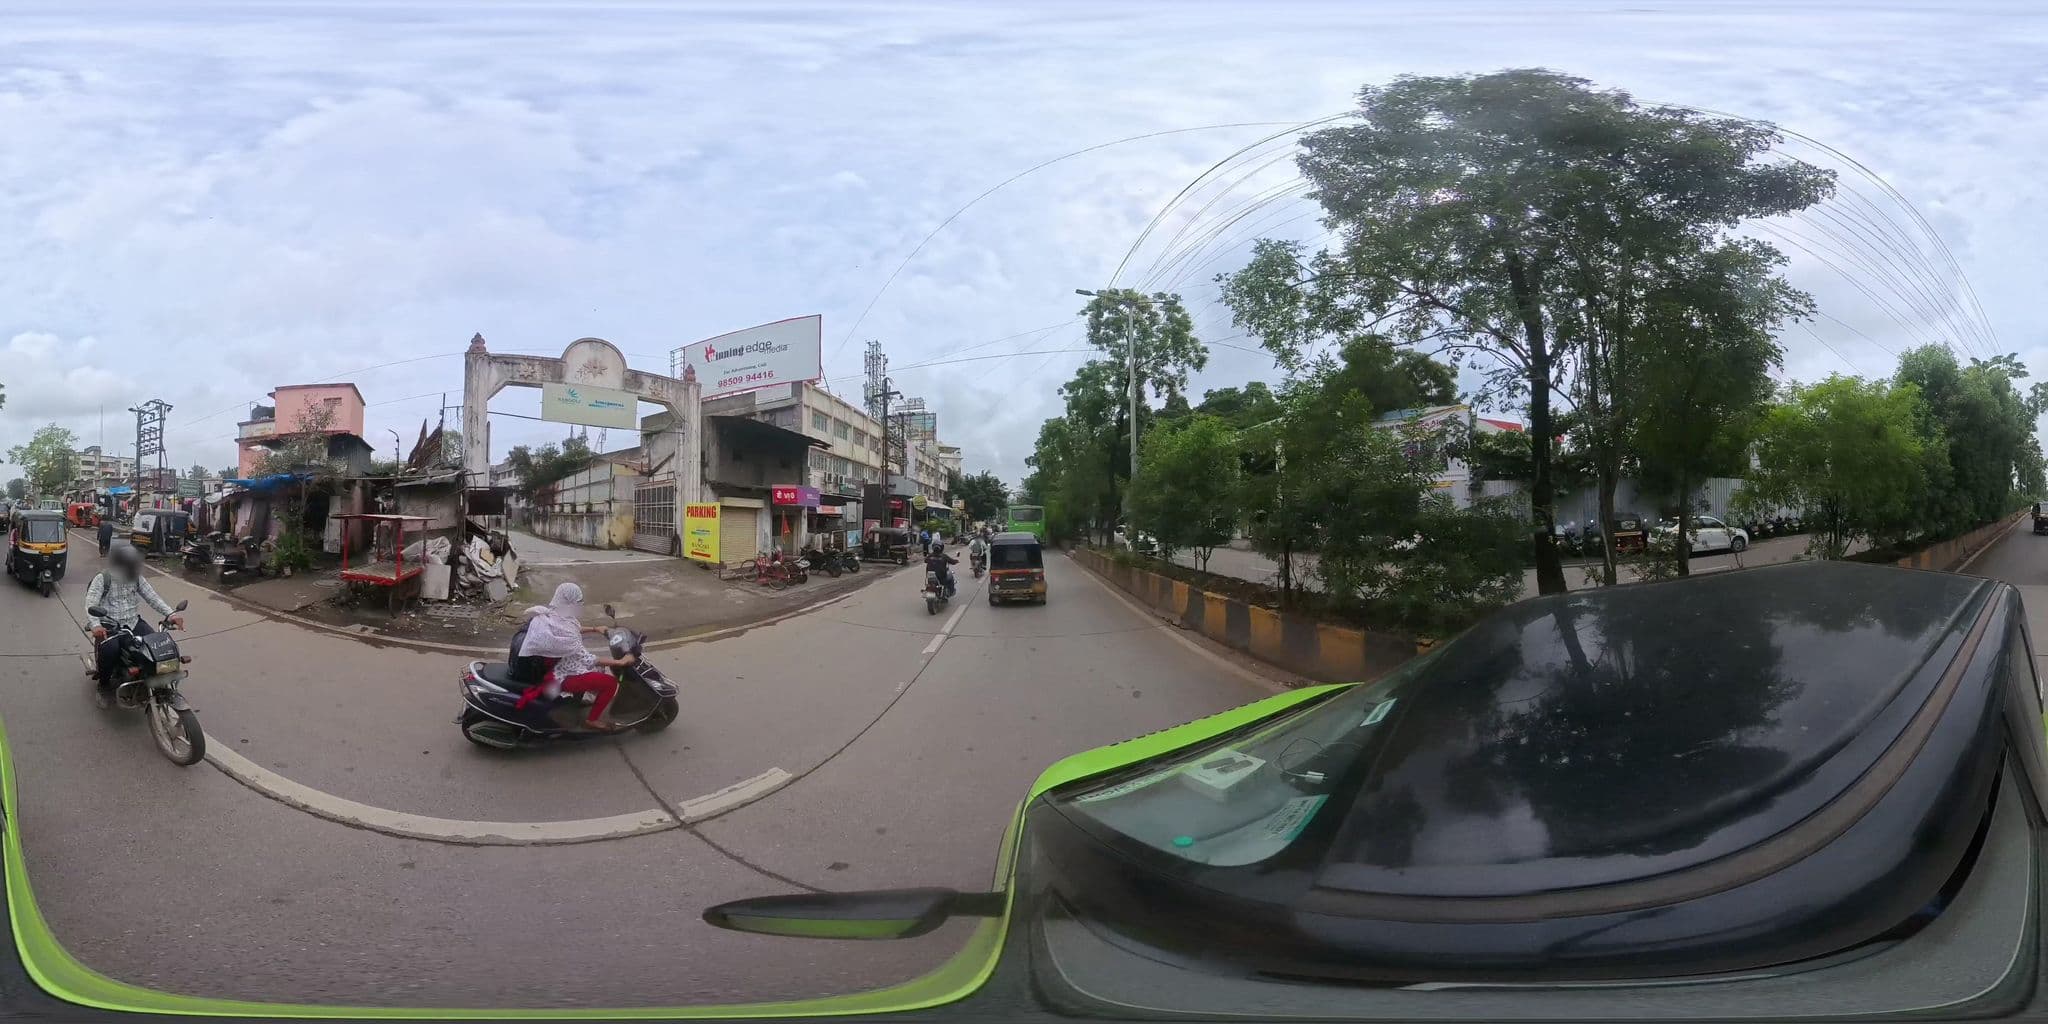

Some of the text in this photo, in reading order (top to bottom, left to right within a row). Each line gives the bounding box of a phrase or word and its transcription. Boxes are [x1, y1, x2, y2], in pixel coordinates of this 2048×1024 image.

[745, 341, 772, 353] edge
[718, 370, 774, 387] 98509 94416
[687, 505, 717, 518] PARKING
